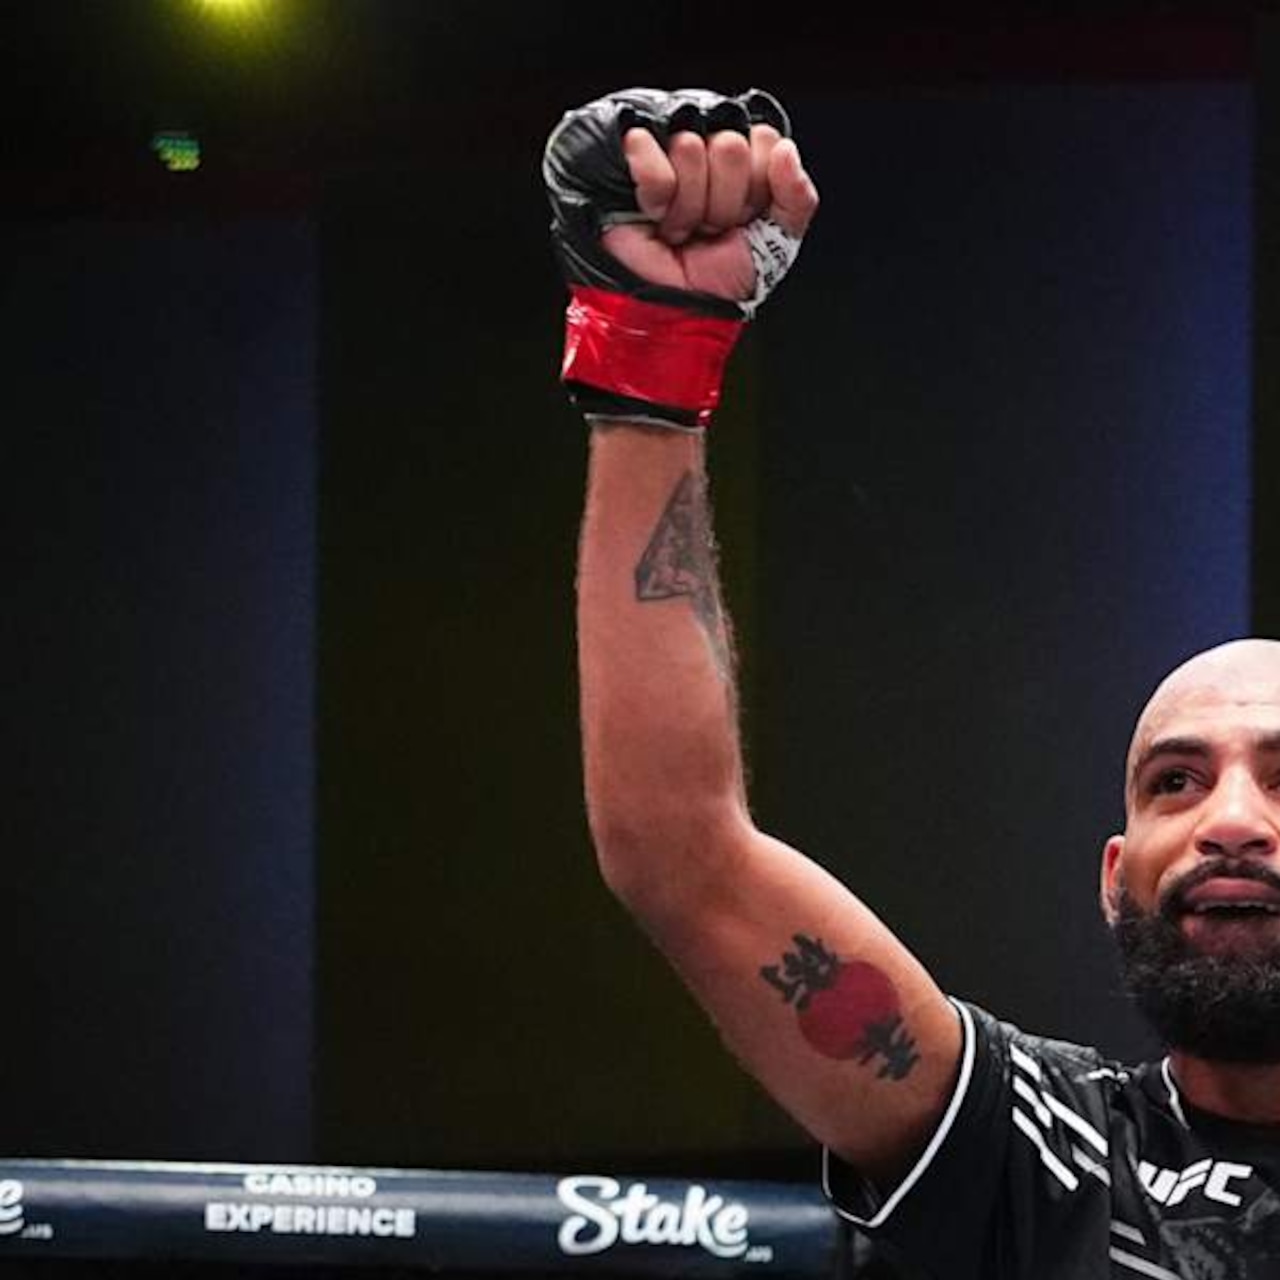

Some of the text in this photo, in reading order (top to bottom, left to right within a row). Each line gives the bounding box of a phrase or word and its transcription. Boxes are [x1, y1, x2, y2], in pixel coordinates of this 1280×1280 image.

[243, 1173, 377, 1199] CASINO
[1137, 1157, 1252, 1206] UFC
[205, 1202, 416, 1237] EXPERIENCE
